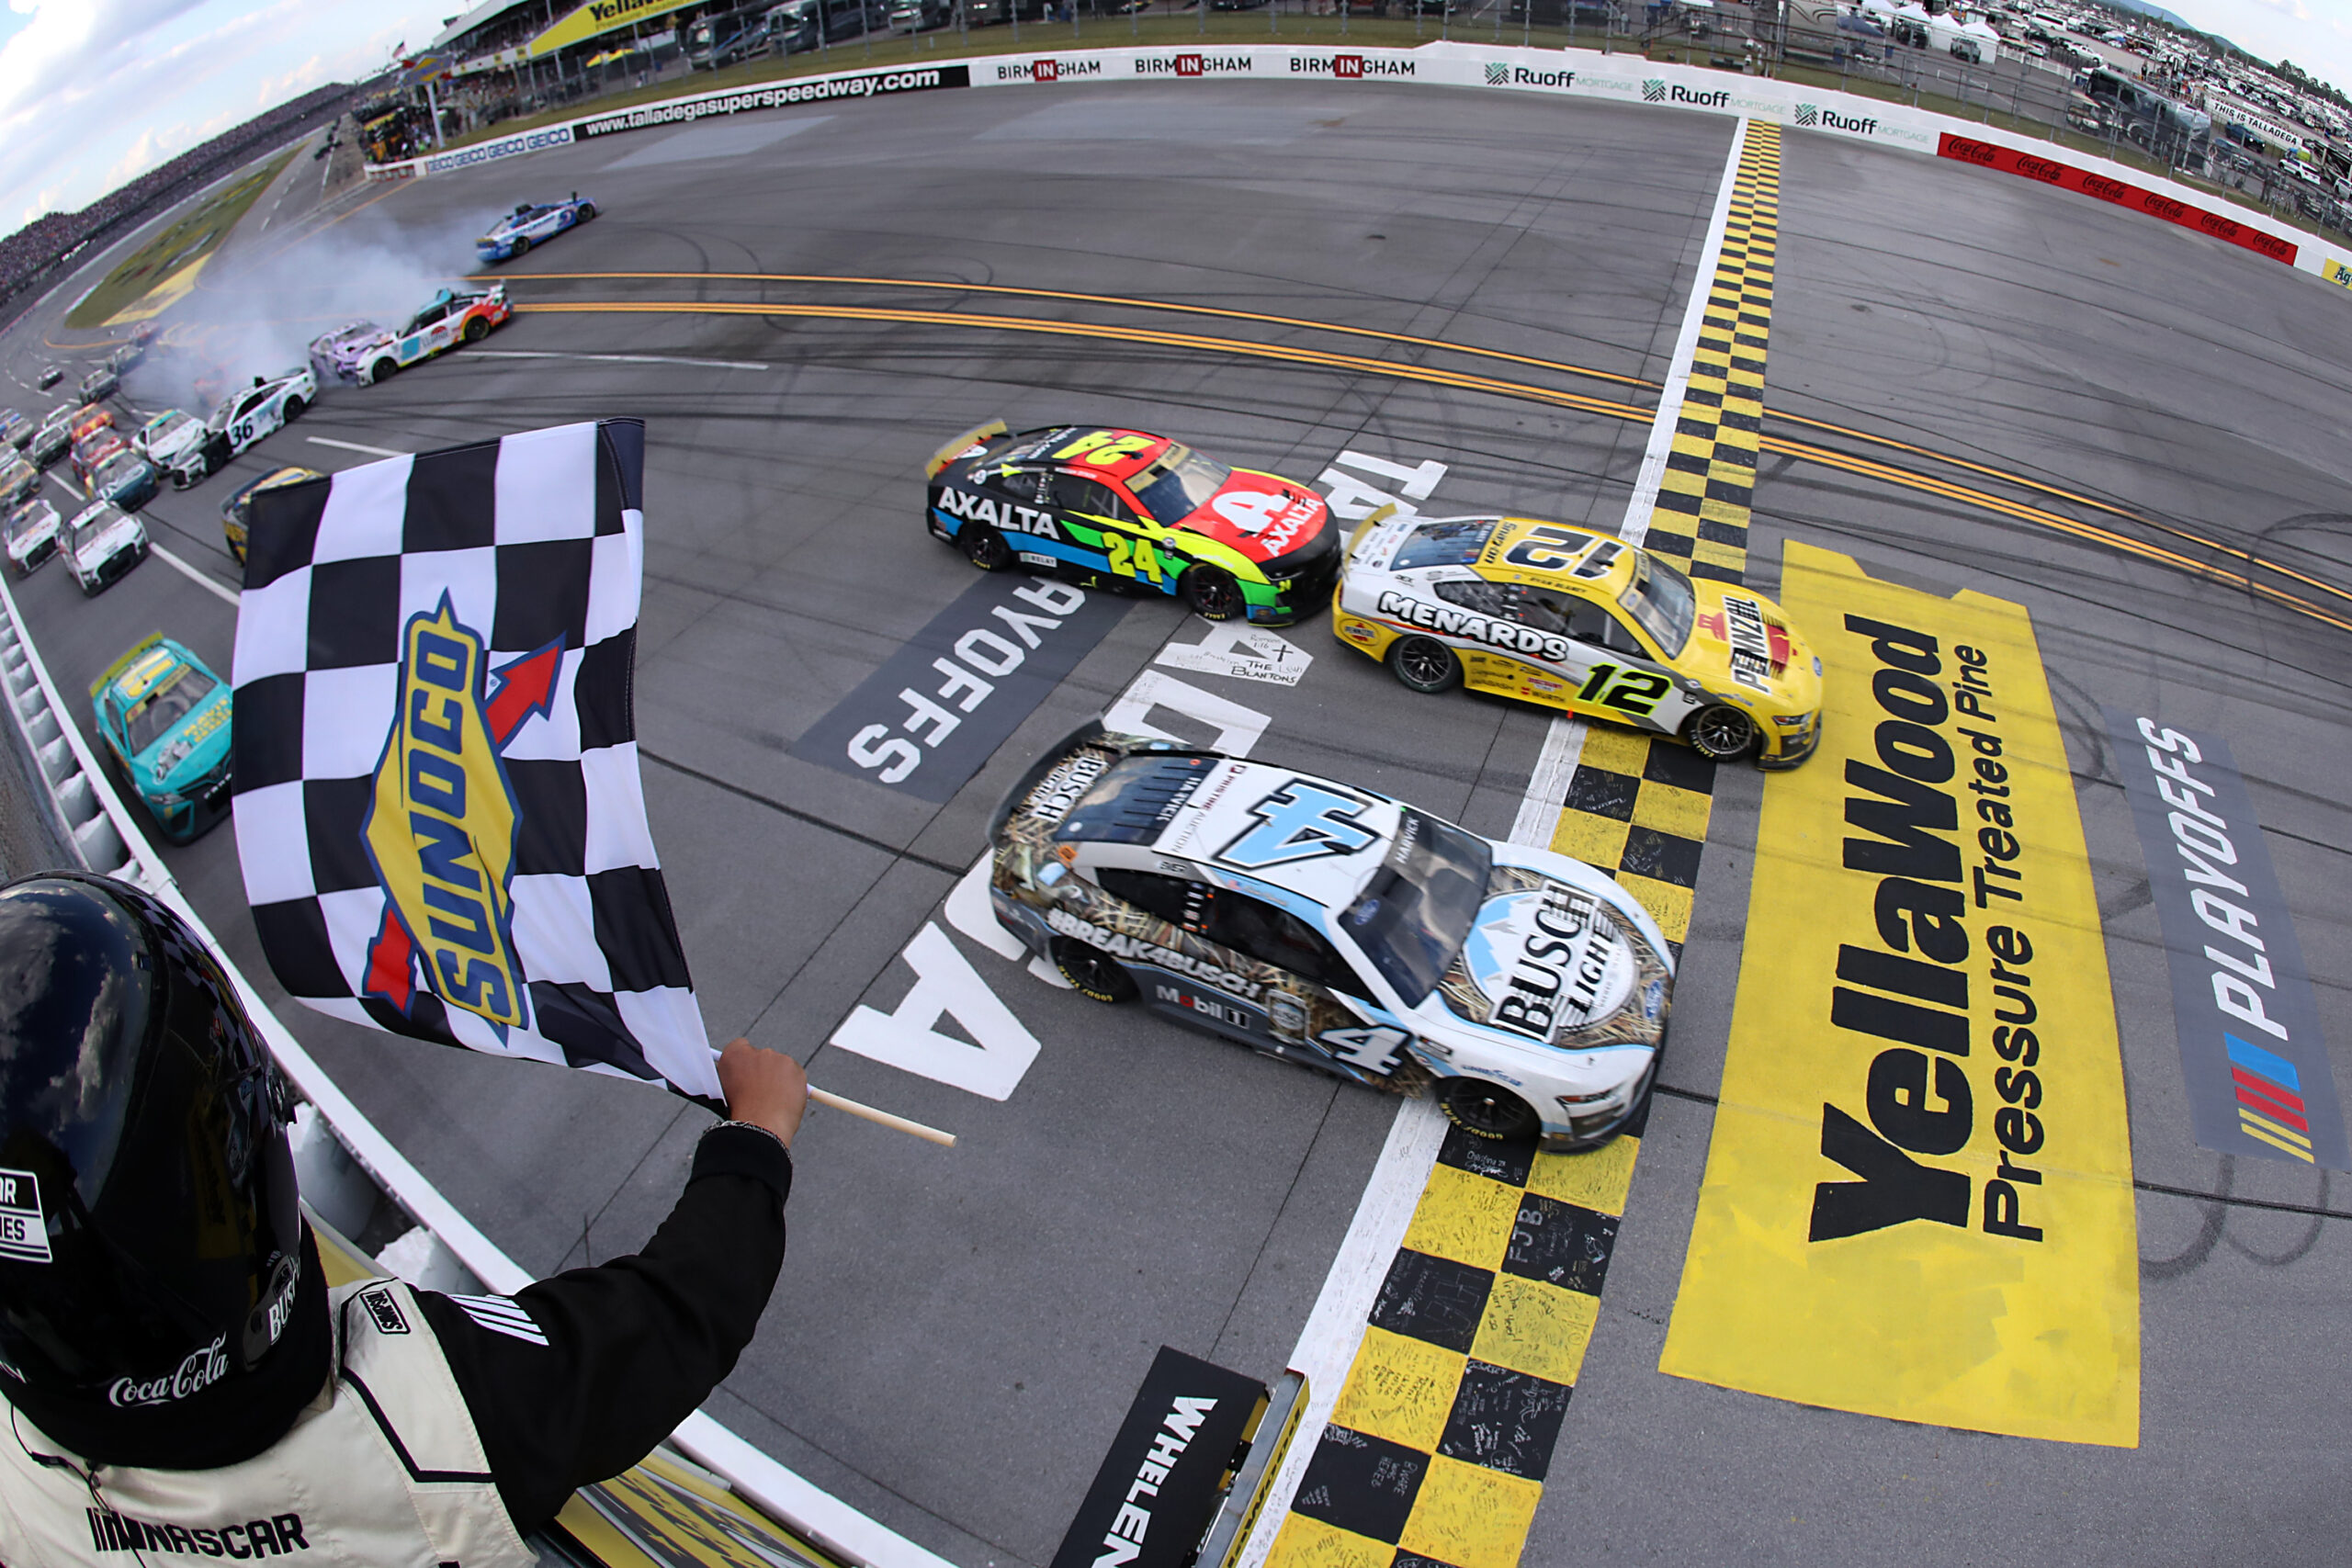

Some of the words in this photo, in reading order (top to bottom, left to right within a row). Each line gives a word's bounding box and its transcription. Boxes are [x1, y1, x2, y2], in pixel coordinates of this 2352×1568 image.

[997, 59, 1101, 82] BIRMINGHAM
[1135, 53, 1251, 77] BIRMINGHAM
[1290, 54, 1415, 78] BIRMINGHAM
[1514, 67, 1575, 89] Ruoff
[1576, 76, 1634, 92] MORTGAGE
[586, 68, 941, 137] www.talladegasuperspeedway.com
[1671, 85, 1729, 108] Ruoff
[1730, 98, 1785, 116] MORTGAGE
[1822, 110, 1878, 135] Ruoff
[2214, 102, 2234, 117] THIS
[2237, 112, 2246, 122] IS
[2248, 117, 2298, 145] TALLADEGA
[455, 147, 487, 167] GEICO
[489, 137, 526, 160] GEICO
[527, 127, 570, 151] GEICO
[2334, 265, 2352, 288] Ag
[231, 416, 254, 448] 36
[1051, 430, 1158, 465] 24
[938, 486, 1060, 540] AXALTA
[1261, 497, 1325, 558] AXALTA
[1102, 531, 1163, 584] 24
[1378, 591, 1569, 663] MENARDS
[847, 576, 1087, 784] AYOFFS
[1231, 666, 1296, 684] BLANTONS
[1247, 660, 1272, 671] THE
[1575, 662, 1673, 718] 12
[1954, 643, 1996, 722] Pine
[1032, 755, 1106, 824] BUSCH
[1156, 776, 1201, 822] HARVICK
[410, 629, 514, 1022] SUNOCO
[1211, 778, 1381, 872] 4
[1394, 816, 1419, 864] HARVICK
[1973, 731, 2024, 910] Treated
[2136, 716, 2289, 1042] PLAYOFFS
[1046, 906, 1262, 998] #BREAK4BUSCH
[1807, 613, 1974, 1242] YellaWood
[1496, 882, 1596, 1037] BUSCH
[1567, 922, 1619, 1016] LIGHT
[1156, 985, 1223, 1020] Mobil
[1318, 1024, 1412, 1077] 4
[1983, 925, 2044, 1243] Pressure
[108, 1330, 230, 1407] Coca-Cola
[1091, 1395, 1218, 1568] WHELEN
[147, 1511, 311, 1560] NASCAR
